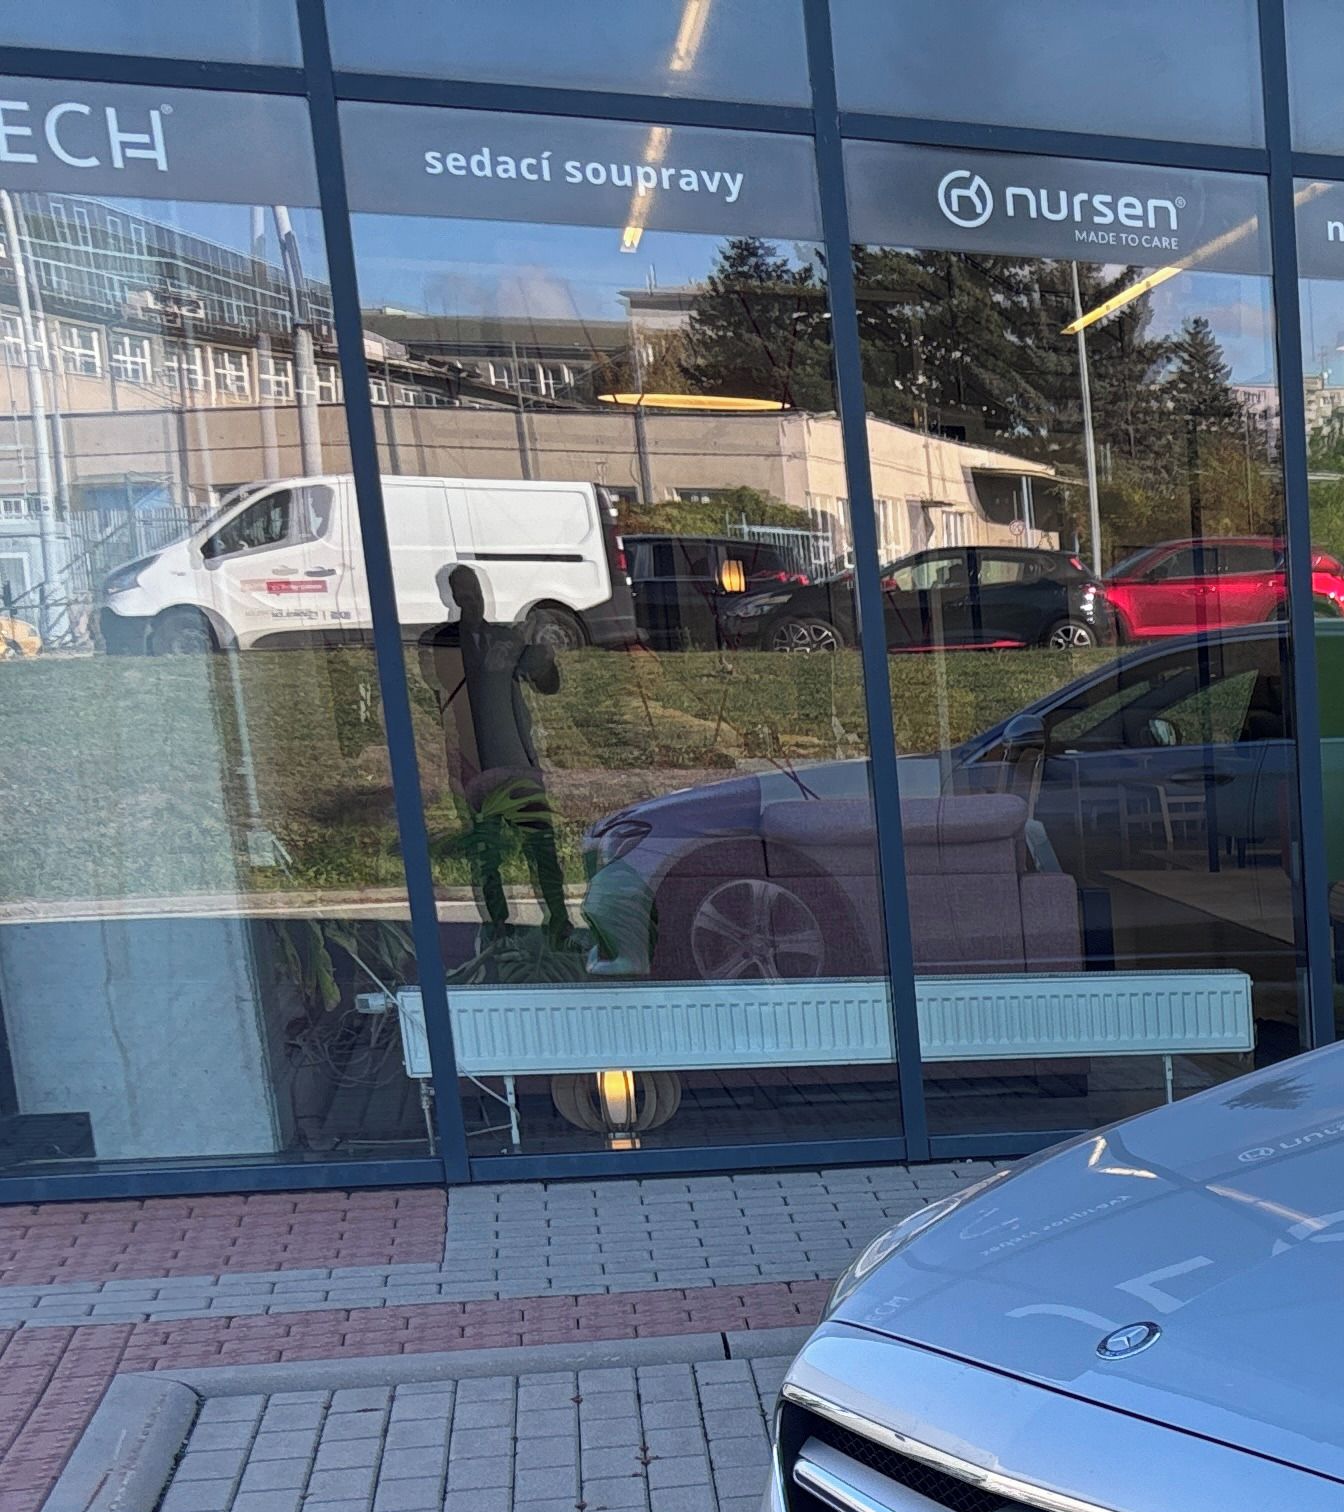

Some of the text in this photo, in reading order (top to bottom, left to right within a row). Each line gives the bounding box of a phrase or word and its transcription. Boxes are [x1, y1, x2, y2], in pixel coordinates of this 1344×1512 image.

[424, 147, 744, 203] sedací soupravy
[1005, 186, 1179, 230] nursen
[1074, 229, 1180, 250] MADE TO CARE
